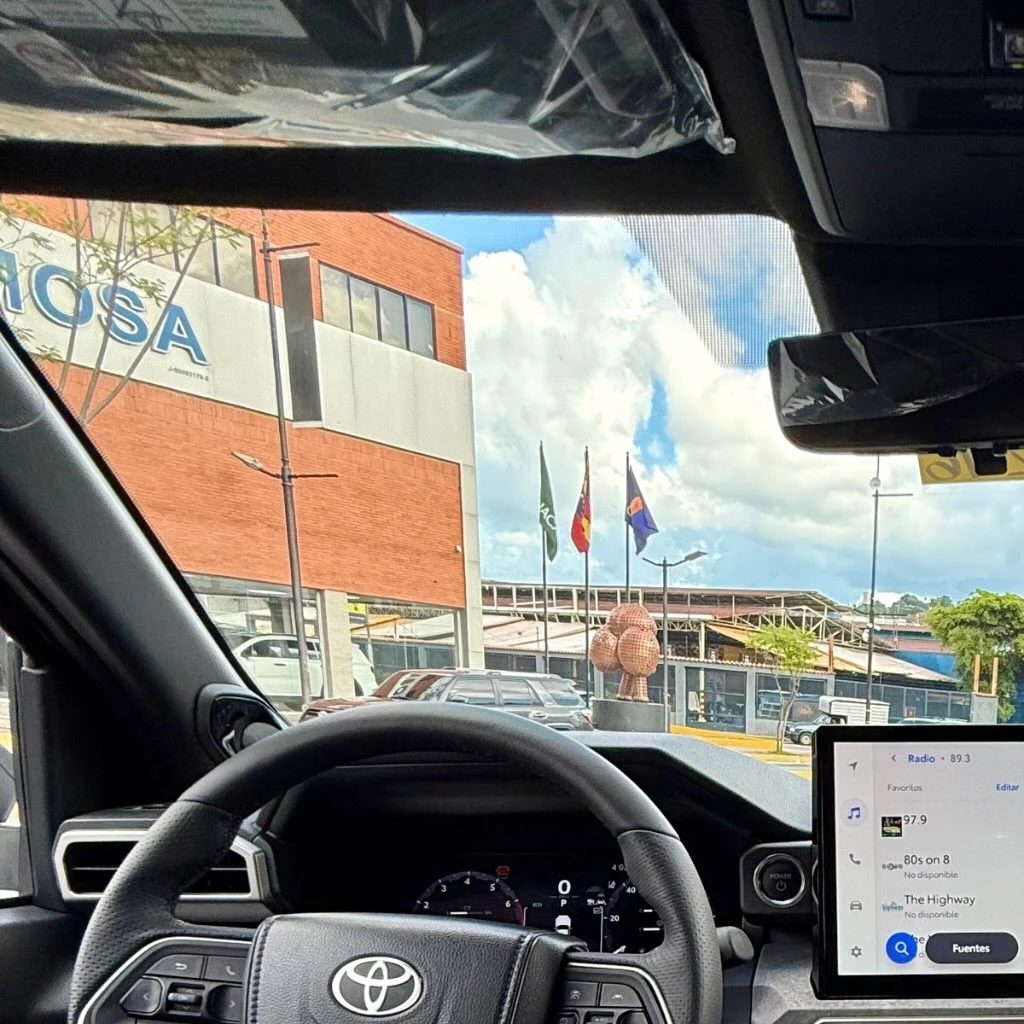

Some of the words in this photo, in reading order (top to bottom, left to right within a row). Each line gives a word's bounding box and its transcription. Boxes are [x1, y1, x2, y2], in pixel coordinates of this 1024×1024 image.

[908, 754, 935, 763] Radio
[950, 754, 971, 763] 89.3
[887, 784, 923, 792] Favoritos
[996, 783, 1019, 791] Editar
[903, 815, 927, 825] 97.9
[903, 855, 923, 865] 80s
[925, 856, 940, 865] on
[943, 855, 950, 864] 8
[917, 871, 959, 880] disponible
[441, 885, 447, 893] 3
[489, 883, 496, 892] 5
[558, 879, 571, 895] 0
[625, 886, 636, 894] 40
[423, 901, 430, 909] 2
[505, 900, 512, 908] 6
[560, 899, 567, 907] P
[904, 895, 925, 904] The
[927, 894, 976, 907] Highway
[610, 914, 620, 922] 20
[918, 911, 959, 920] disponible
[952, 943, 991, 953] Fuentes
